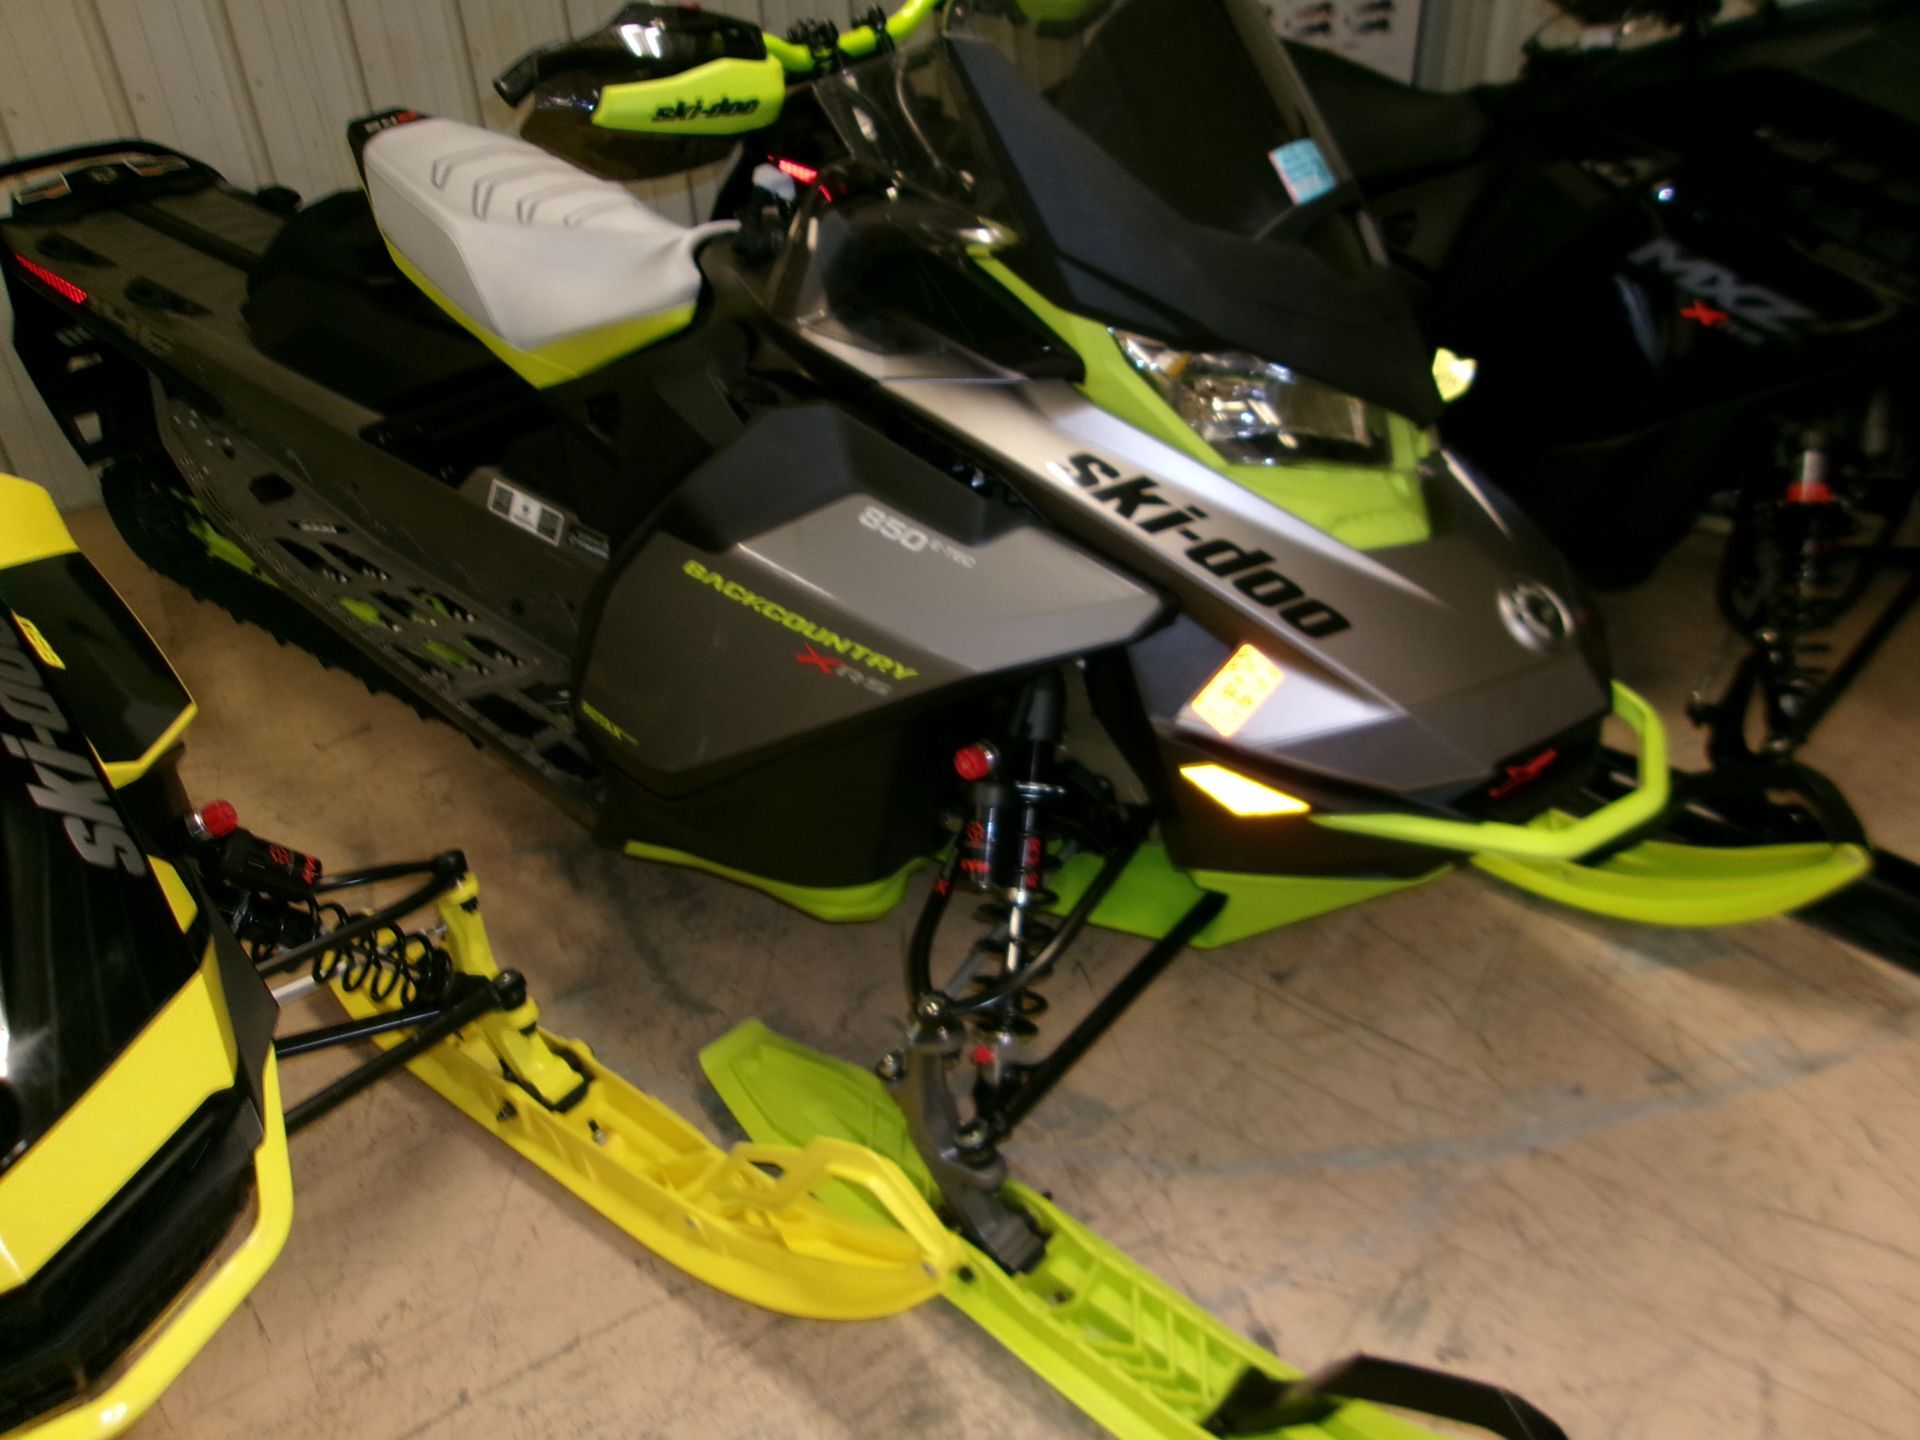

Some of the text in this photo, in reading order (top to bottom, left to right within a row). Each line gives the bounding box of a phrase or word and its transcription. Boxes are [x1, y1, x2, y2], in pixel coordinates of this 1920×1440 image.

[652, 96, 759, 121] ski-doo
[858, 505, 928, 552] 850
[1064, 452, 1351, 637] ski-doo
[682, 559, 919, 680] BACKCOUNTRY
